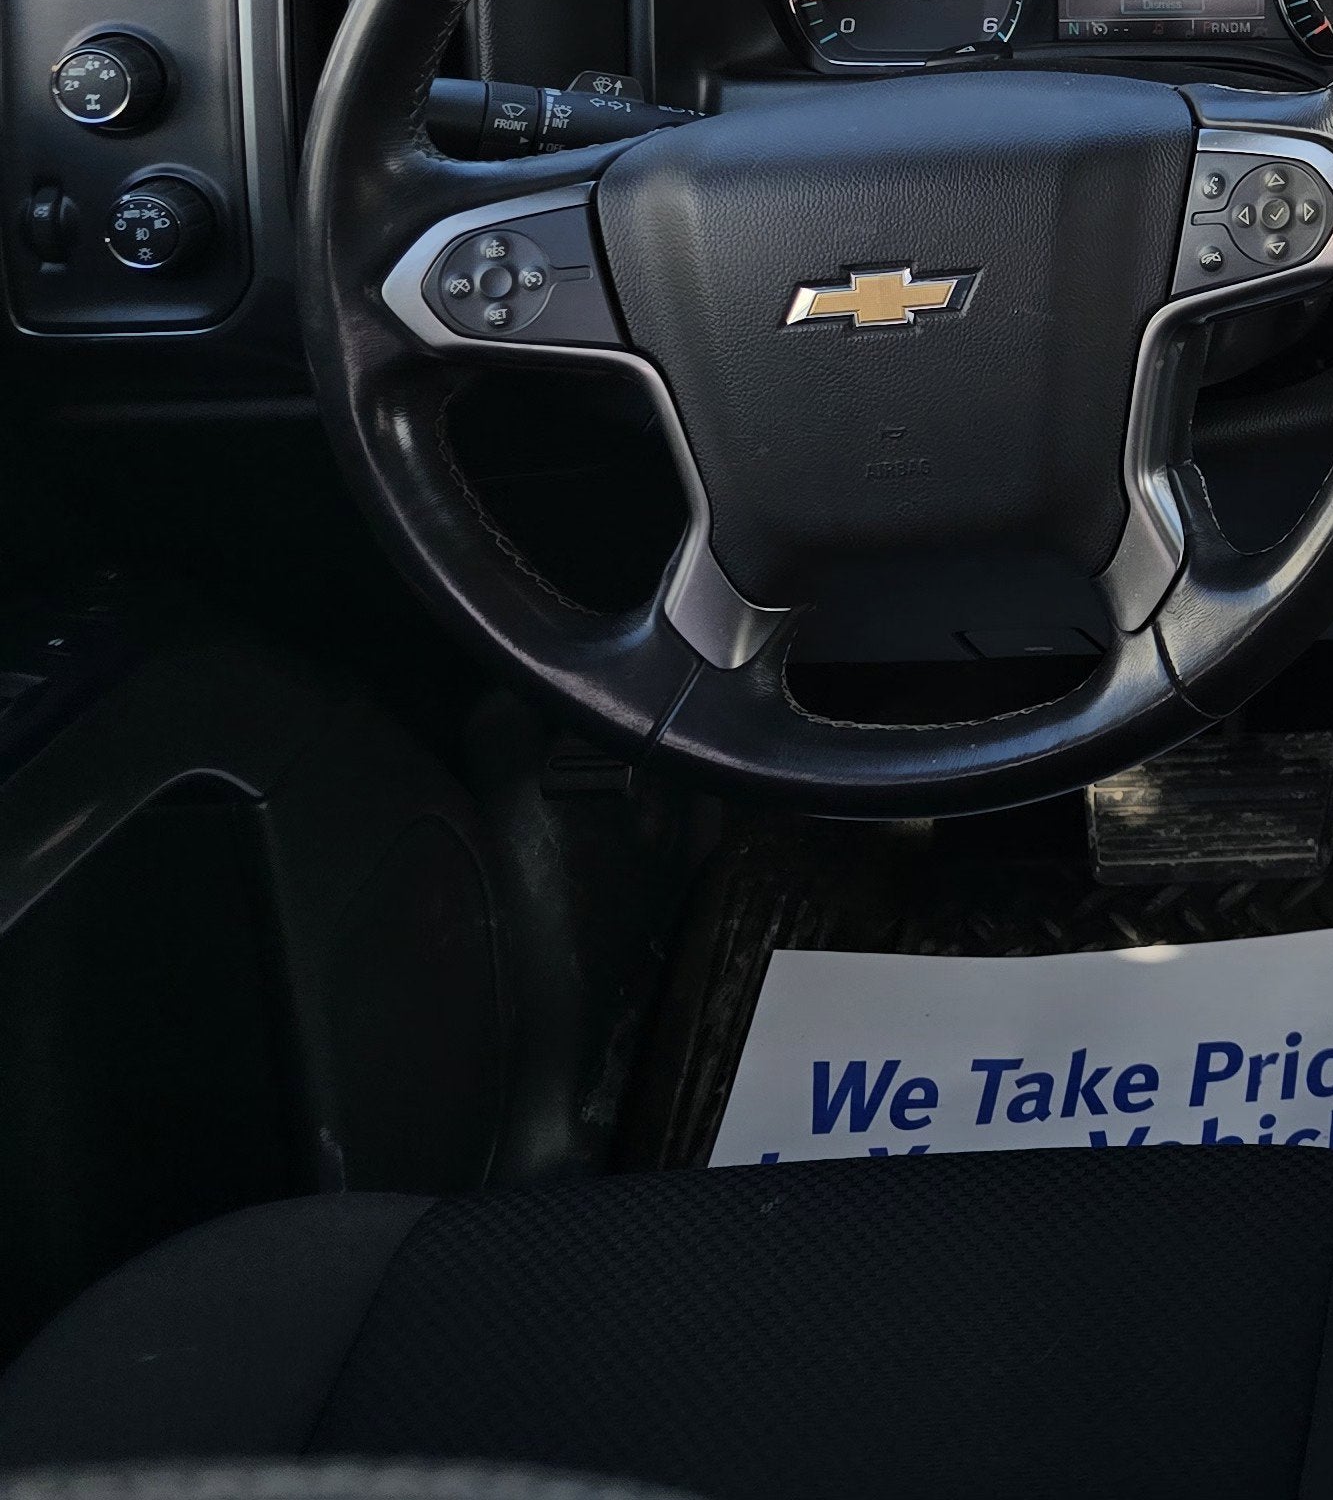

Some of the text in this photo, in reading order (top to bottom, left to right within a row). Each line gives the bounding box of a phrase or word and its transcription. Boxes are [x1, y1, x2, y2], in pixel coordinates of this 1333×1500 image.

[840, 18, 856, 34] 0
[983, 17, 999, 34] 6
[1068, 22, 1079, 35] N
[494, 118, 529, 133] FRONT
[552, 117, 570, 129] INT
[485, 246, 506, 258] RES
[489, 308, 508, 321] SET
[811, 1059, 940, 1136] We
[970, 1047, 1160, 1127] Take
